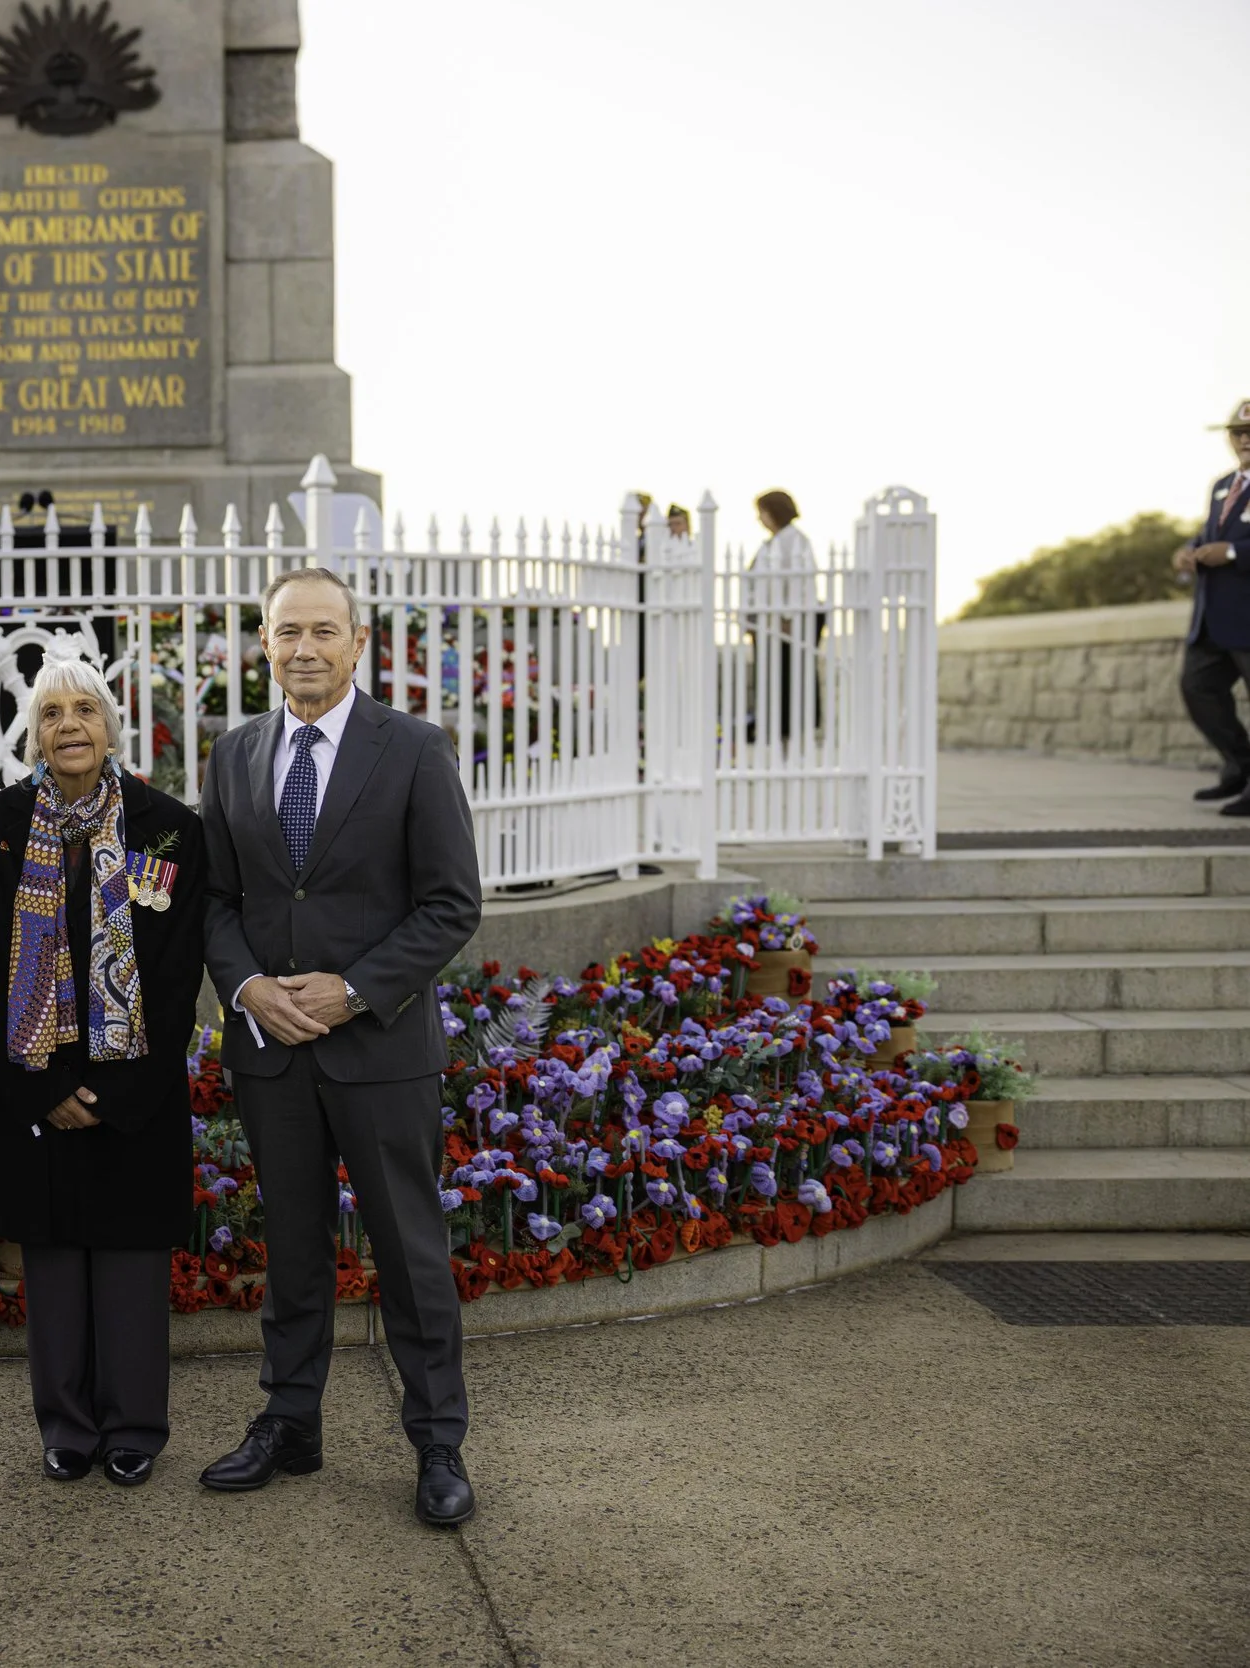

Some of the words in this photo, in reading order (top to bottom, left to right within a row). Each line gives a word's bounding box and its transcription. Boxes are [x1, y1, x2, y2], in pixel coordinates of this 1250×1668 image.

[97, 187, 186, 209] CITIZENS
[170, 211, 204, 241] OF
[4, 252, 37, 284] OF
[50, 251, 107, 284] THIS
[116, 249, 200, 282] STATE
[15, 292, 52, 310] THE
[60, 291, 106, 310] CALL
[113, 290, 138, 308] OF
[144, 288, 199, 308] DUTY
[12, 316, 71, 336] THEIR
[79, 315, 136, 335] LIVES
[142, 314, 183, 334] FOR
[38, 342, 80, 362] AND
[86, 340, 200, 361] HUMANITY
[18, 376, 108, 410] GREAT
[119, 375, 186, 406] WAR
